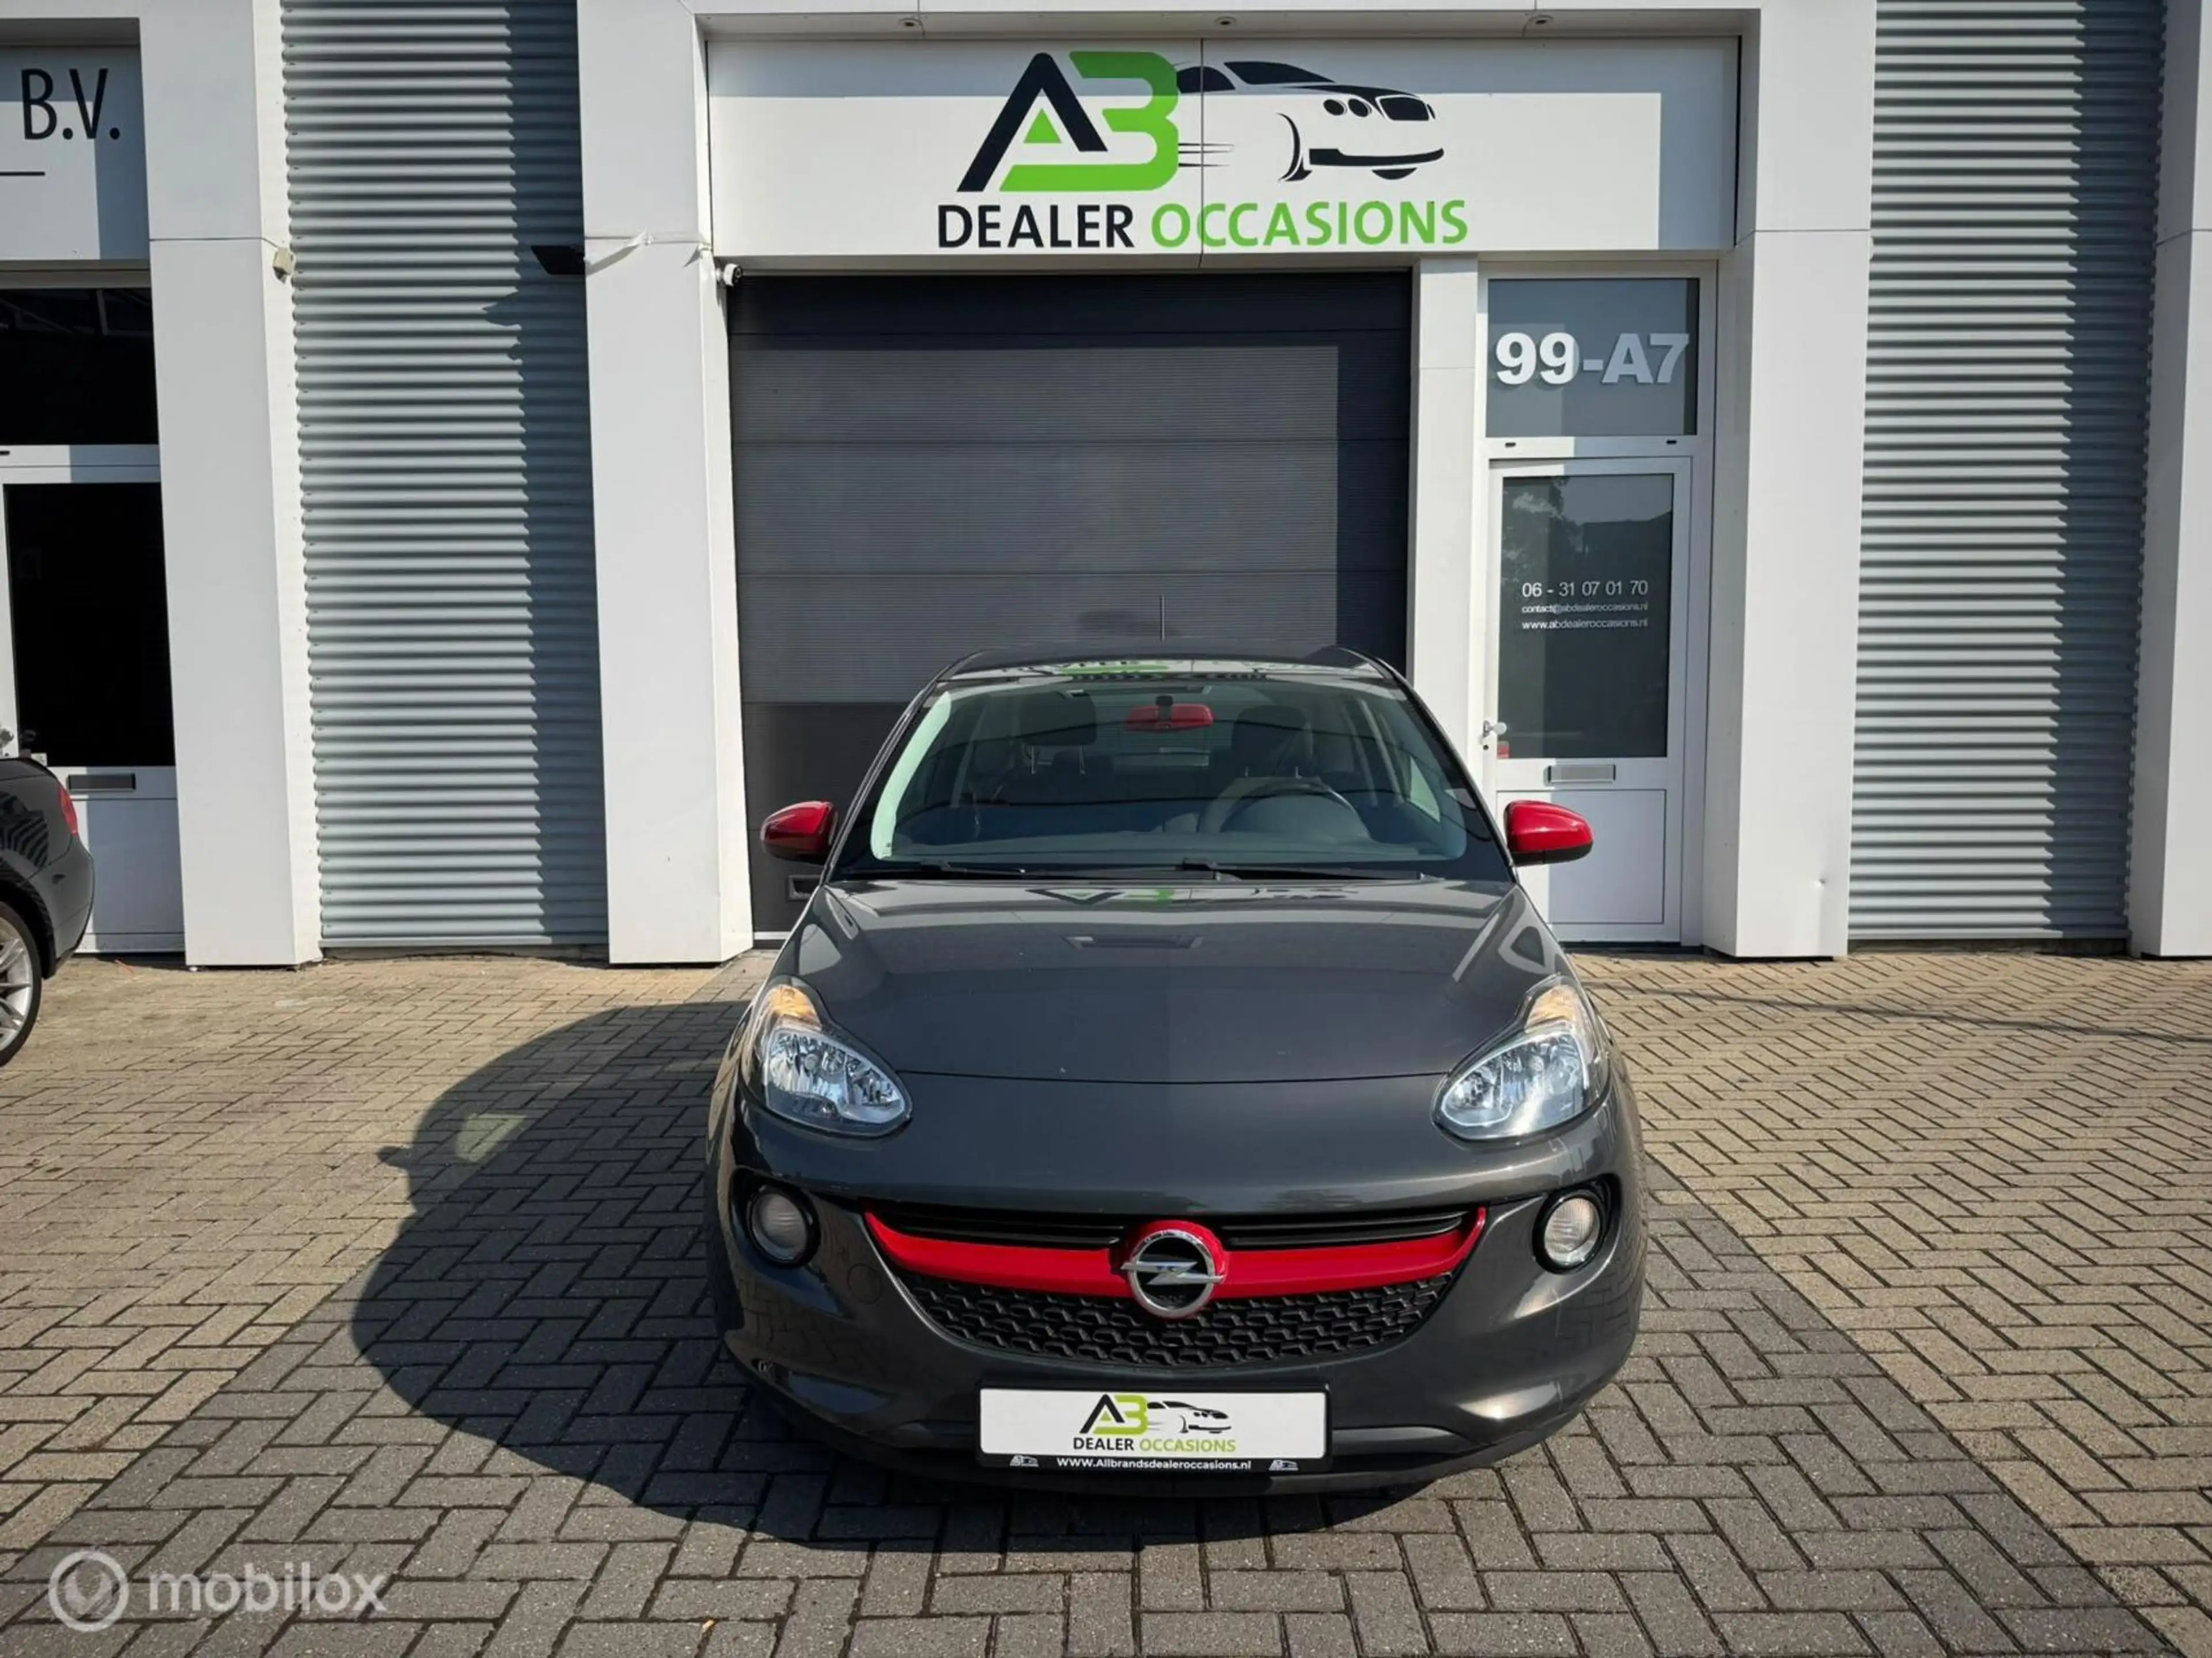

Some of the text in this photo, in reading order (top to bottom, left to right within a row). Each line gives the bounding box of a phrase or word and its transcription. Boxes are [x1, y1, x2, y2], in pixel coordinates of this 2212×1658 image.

[21, 69, 120, 141] B.V.
[957, 50, 1179, 192] AB
[938, 200, 1468, 248] DEALER OCCASIONS
[1495, 332, 1690, 385] 99-A7
[1522, 582, 1543, 597] 06
[1559, 582, 1575, 597] 31
[1582, 581, 1600, 596] 07
[1605, 581, 1622, 595] 01
[1629, 580, 1648, 595] 70
[1521, 619, 1648, 629] www.abdealeroccasions.nl
[1073, 1437, 1236, 1453] DEALER OCCASIONS
